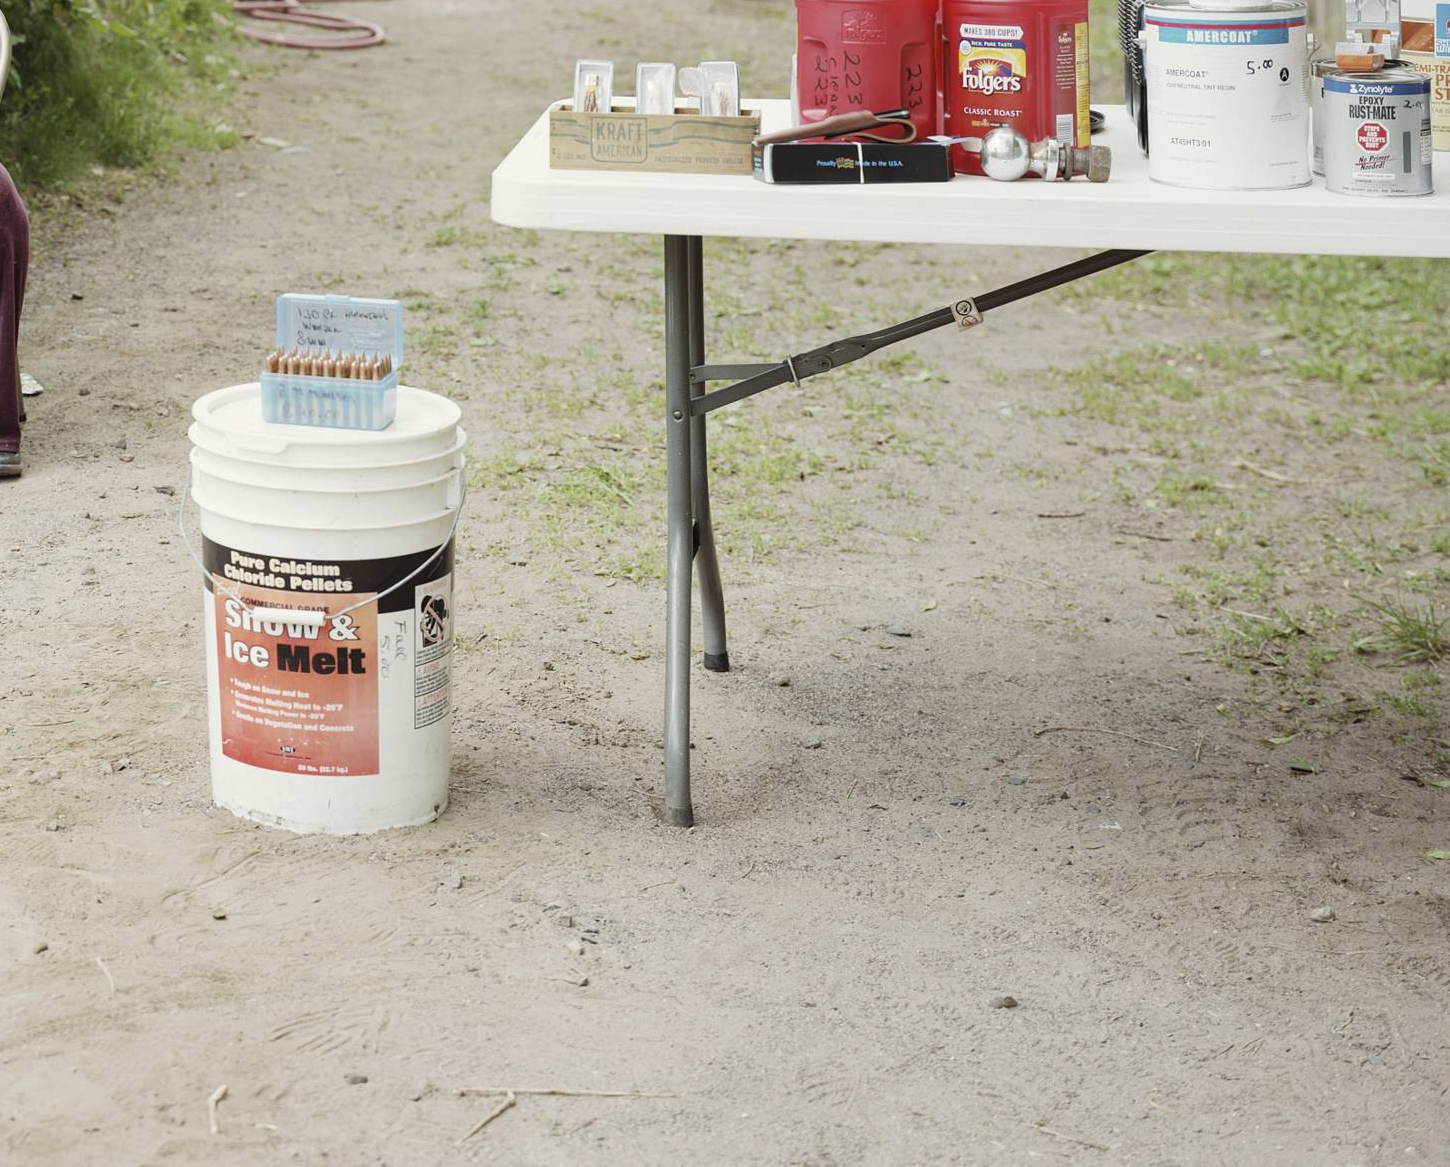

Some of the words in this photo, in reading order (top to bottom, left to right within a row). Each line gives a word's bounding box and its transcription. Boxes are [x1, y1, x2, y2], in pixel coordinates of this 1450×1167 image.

[1246, 59, 1273, 75] 5.00
[844, 50, 863, 105] 223
[962, 66, 1021, 95] Folgers
[1359, 96, 1384, 105] EPOXY
[963, 107, 992, 116] CLASSIC
[993, 109, 1020, 117] ROAST
[1349, 105, 1396, 120] RUST-MATE
[596, 122, 643, 141] KRAFT
[596, 144, 643, 158] AMERICAN
[1369, 154, 1390, 162] Primer
[816, 159, 837, 168] Proudly
[1361, 161, 1386, 170] Needed!
[230, 550, 265, 570] Pure
[269, 558, 340, 576] Calcium
[224, 563, 285, 589] Chloride
[290, 576, 353, 591] Pellets
[240, 596, 293, 610] COMMERCIAL
[297, 605, 330, 614] GRADE
[225, 598, 321, 640] Snow
[328, 614, 359, 641] &
[224, 631, 269, 668] Ice
[277, 644, 366, 674] Melt
[234, 678, 251, 690] Tough
[262, 686, 281, 696] Snow
[297, 691, 310, 699] Ice
[266, 698, 292, 710] Melting
[293, 702, 311, 710] Heat
[255, 716, 263, 724] on
[264, 716, 302, 730] Vegetation
[319, 724, 354, 732] Concrete
